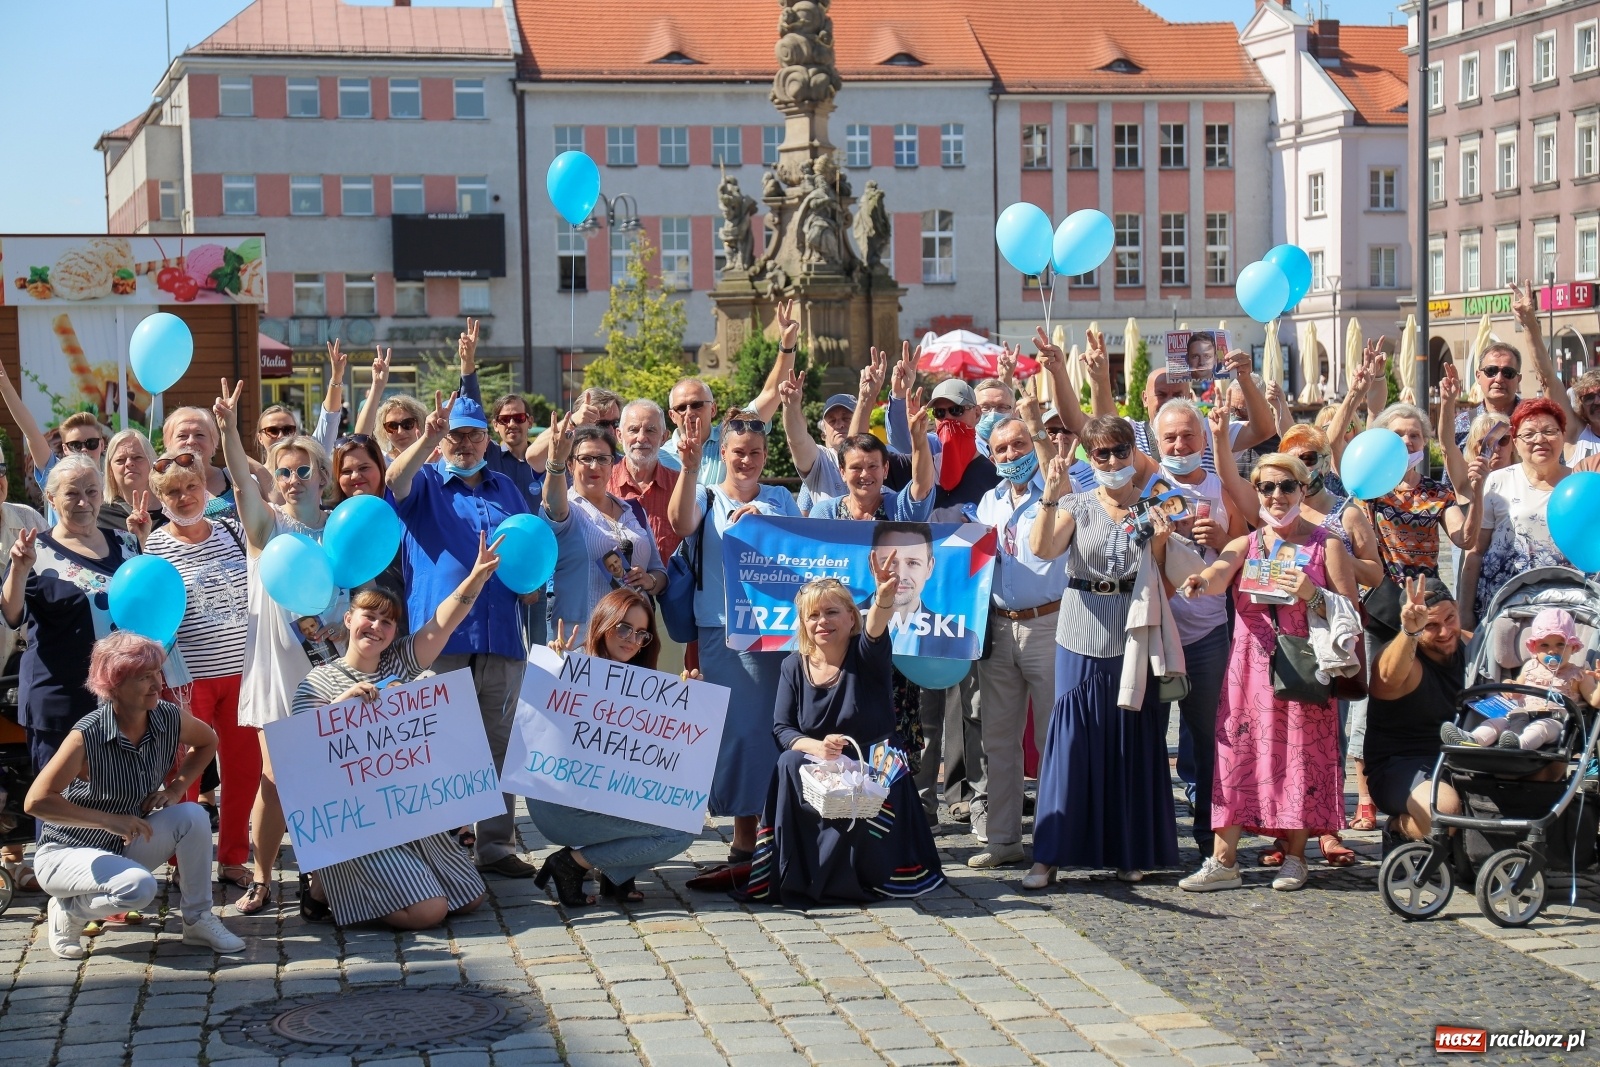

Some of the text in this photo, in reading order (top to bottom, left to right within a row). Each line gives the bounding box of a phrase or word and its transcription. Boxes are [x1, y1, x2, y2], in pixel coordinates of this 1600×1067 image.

[1464, 294, 1512, 316] KANTOR
[1575, 285, 1588, 303] T
[261, 354, 287, 368] Italia
[739, 551, 849, 569] Silny Prezydent
[739, 569, 800, 584] Wspólna
[735, 605, 966, 638] TRZWSKI
[559, 654, 591, 687] NA
[316, 683, 450, 737] LEKARSTWEM
[546, 688, 709, 745] NIE GŁOSUJEMY
[328, 714, 438, 763] NA NASZE
[572, 721, 683, 772] RAFAŁOWI
[524, 751, 707, 811] DOBRZE WINSZUJEMY
[288, 763, 497, 847] RAFAŁ TRZASKOWSKI
